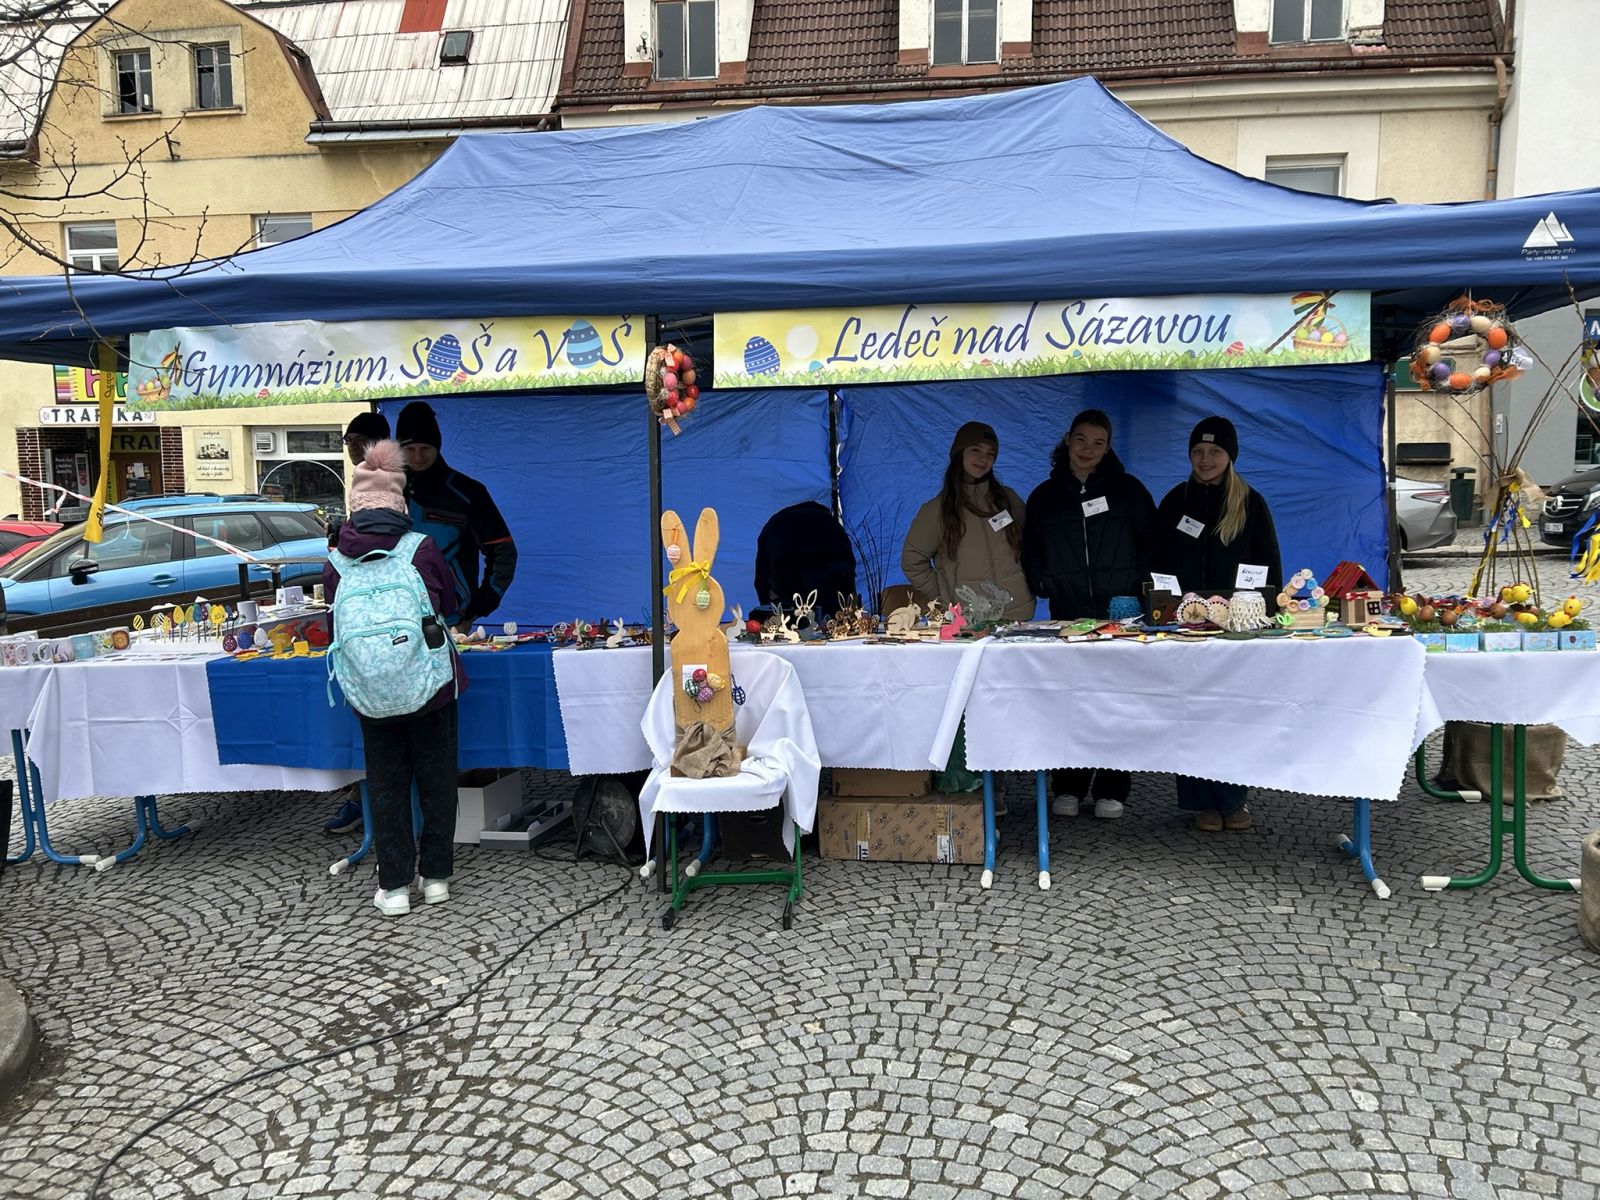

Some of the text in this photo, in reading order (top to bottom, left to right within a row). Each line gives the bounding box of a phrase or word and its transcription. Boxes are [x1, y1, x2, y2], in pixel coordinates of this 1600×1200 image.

[826, 299, 1232, 364] Ledeč nad Sázavou
[495, 347, 518, 373] a
